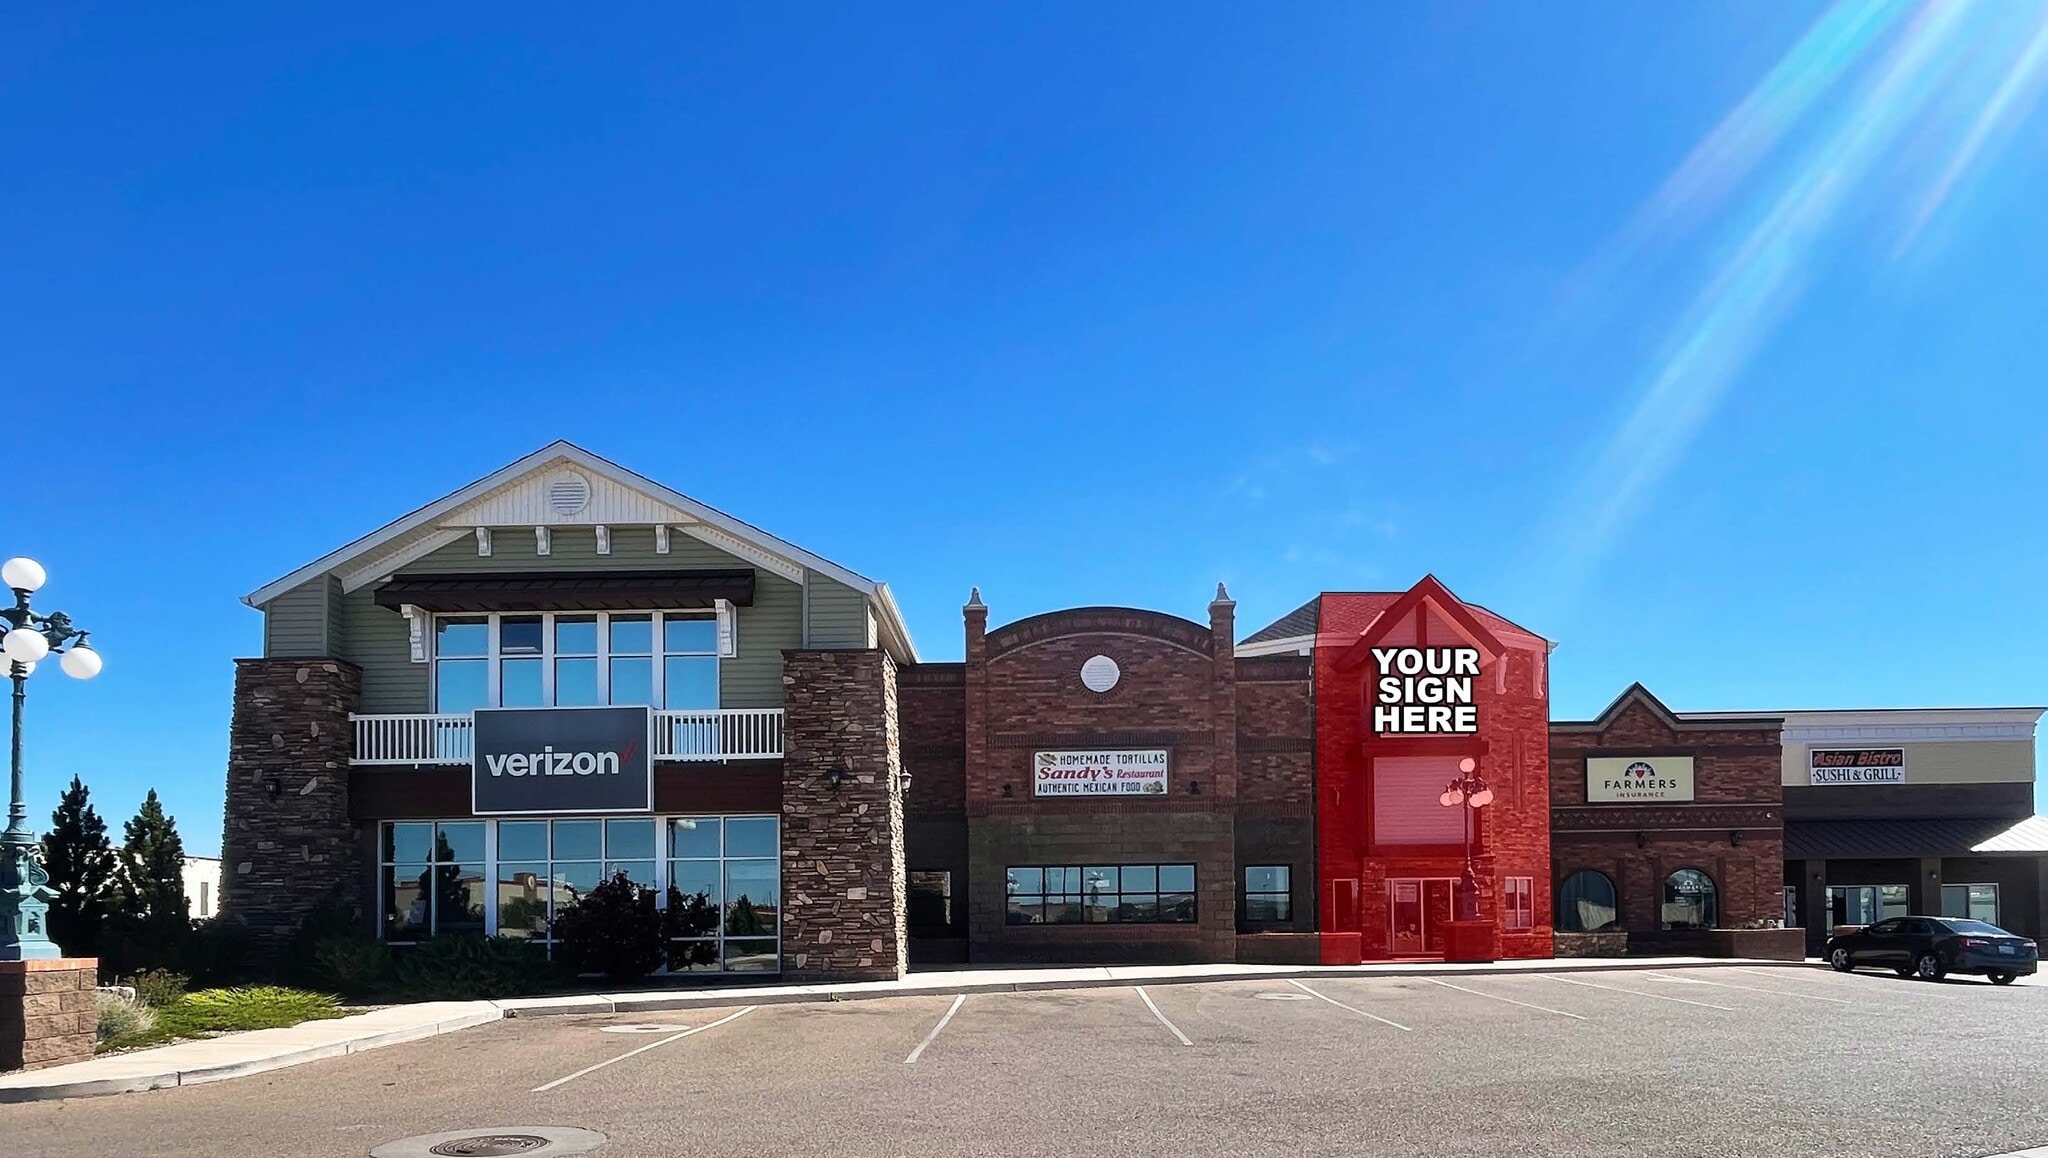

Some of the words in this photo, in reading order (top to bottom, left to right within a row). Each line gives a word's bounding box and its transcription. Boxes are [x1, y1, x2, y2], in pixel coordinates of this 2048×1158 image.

[485, 745, 620, 777] verizon
[1060, 754, 1111, 765] HOMEMADE
[1117, 753, 1165, 764] TORTILLAS
[1813, 752, 1855, 766] Asian
[1857, 752, 1901, 766] Bistro
[1038, 766, 1113, 781] Sandy's
[1117, 769, 1164, 779] Restaurant
[1816, 768, 1850, 781] SUSHI
[1853, 769, 1861, 780] &
[1864, 768, 1899, 780] GRILL
[1037, 783, 1079, 793] AUTHENTIC
[1083, 783, 1117, 792] MEXICAN
[1121, 782, 1140, 792] FOOD
[1604, 779, 1677, 789] FARMERS
